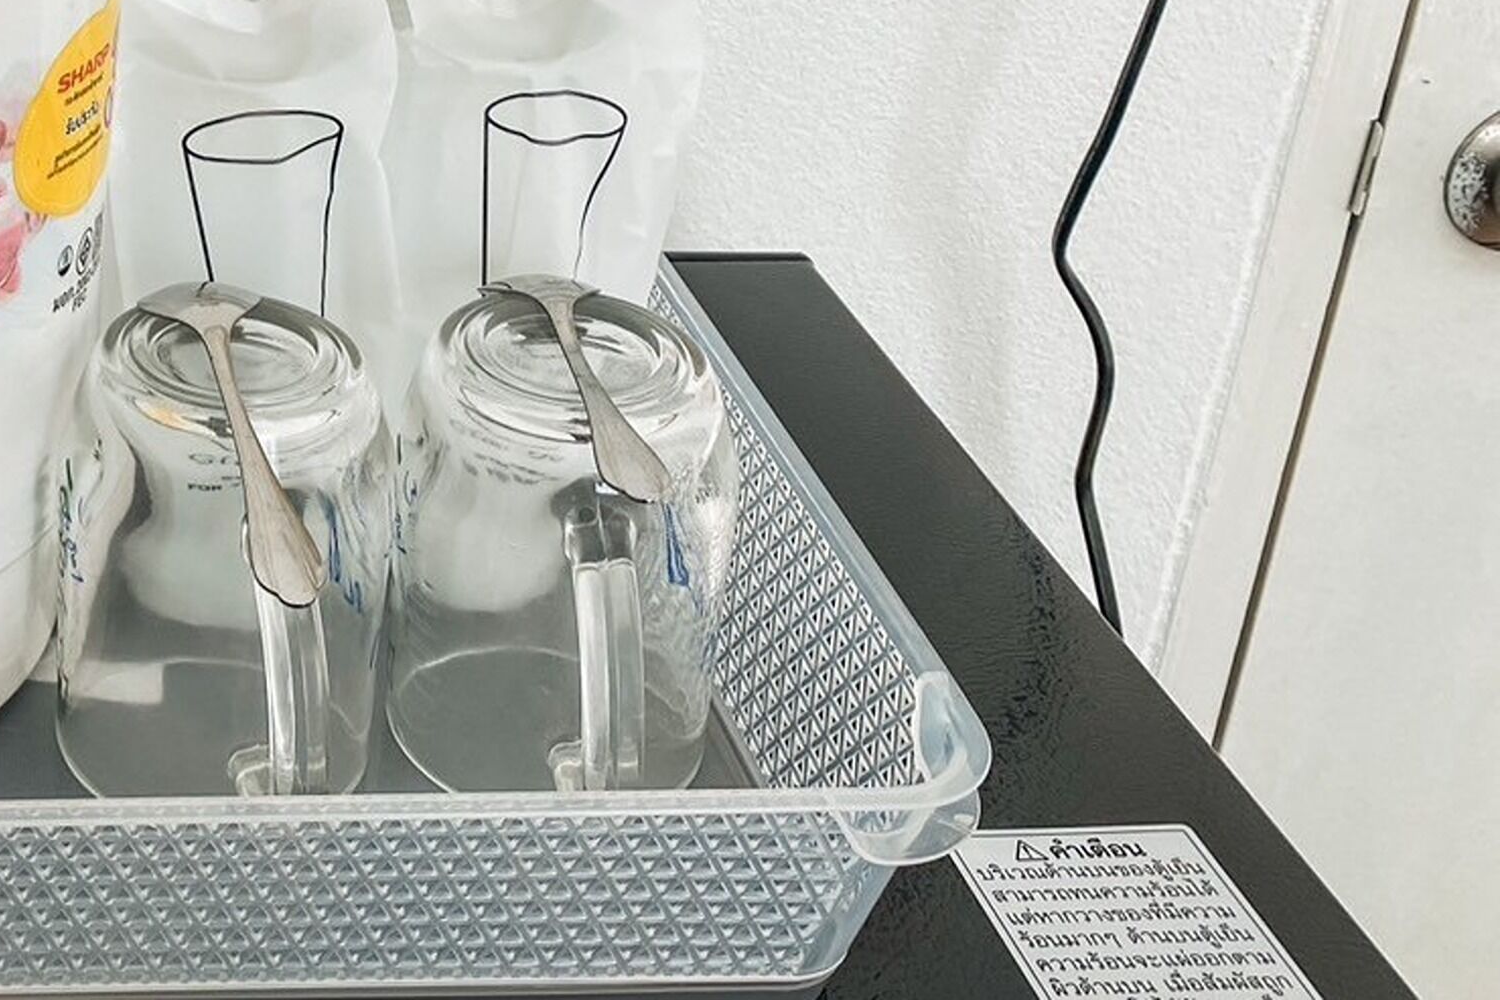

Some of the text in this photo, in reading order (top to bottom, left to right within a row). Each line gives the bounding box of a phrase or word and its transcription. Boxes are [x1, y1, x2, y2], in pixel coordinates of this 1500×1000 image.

[57, 43, 111, 95] SHARP
[1049, 837, 1147, 861] คำเตือน
[977, 856, 1206, 883] บริเวณด้านบนของตู้เย็น
[991, 878, 1221, 904] สามารถทนความร้อนได้
[1128, 924, 1255, 950] ด้านบนตู้เย็น
[1049, 970, 1294, 997] ผิวด้านบน เมื่อสัมผัสถูก
